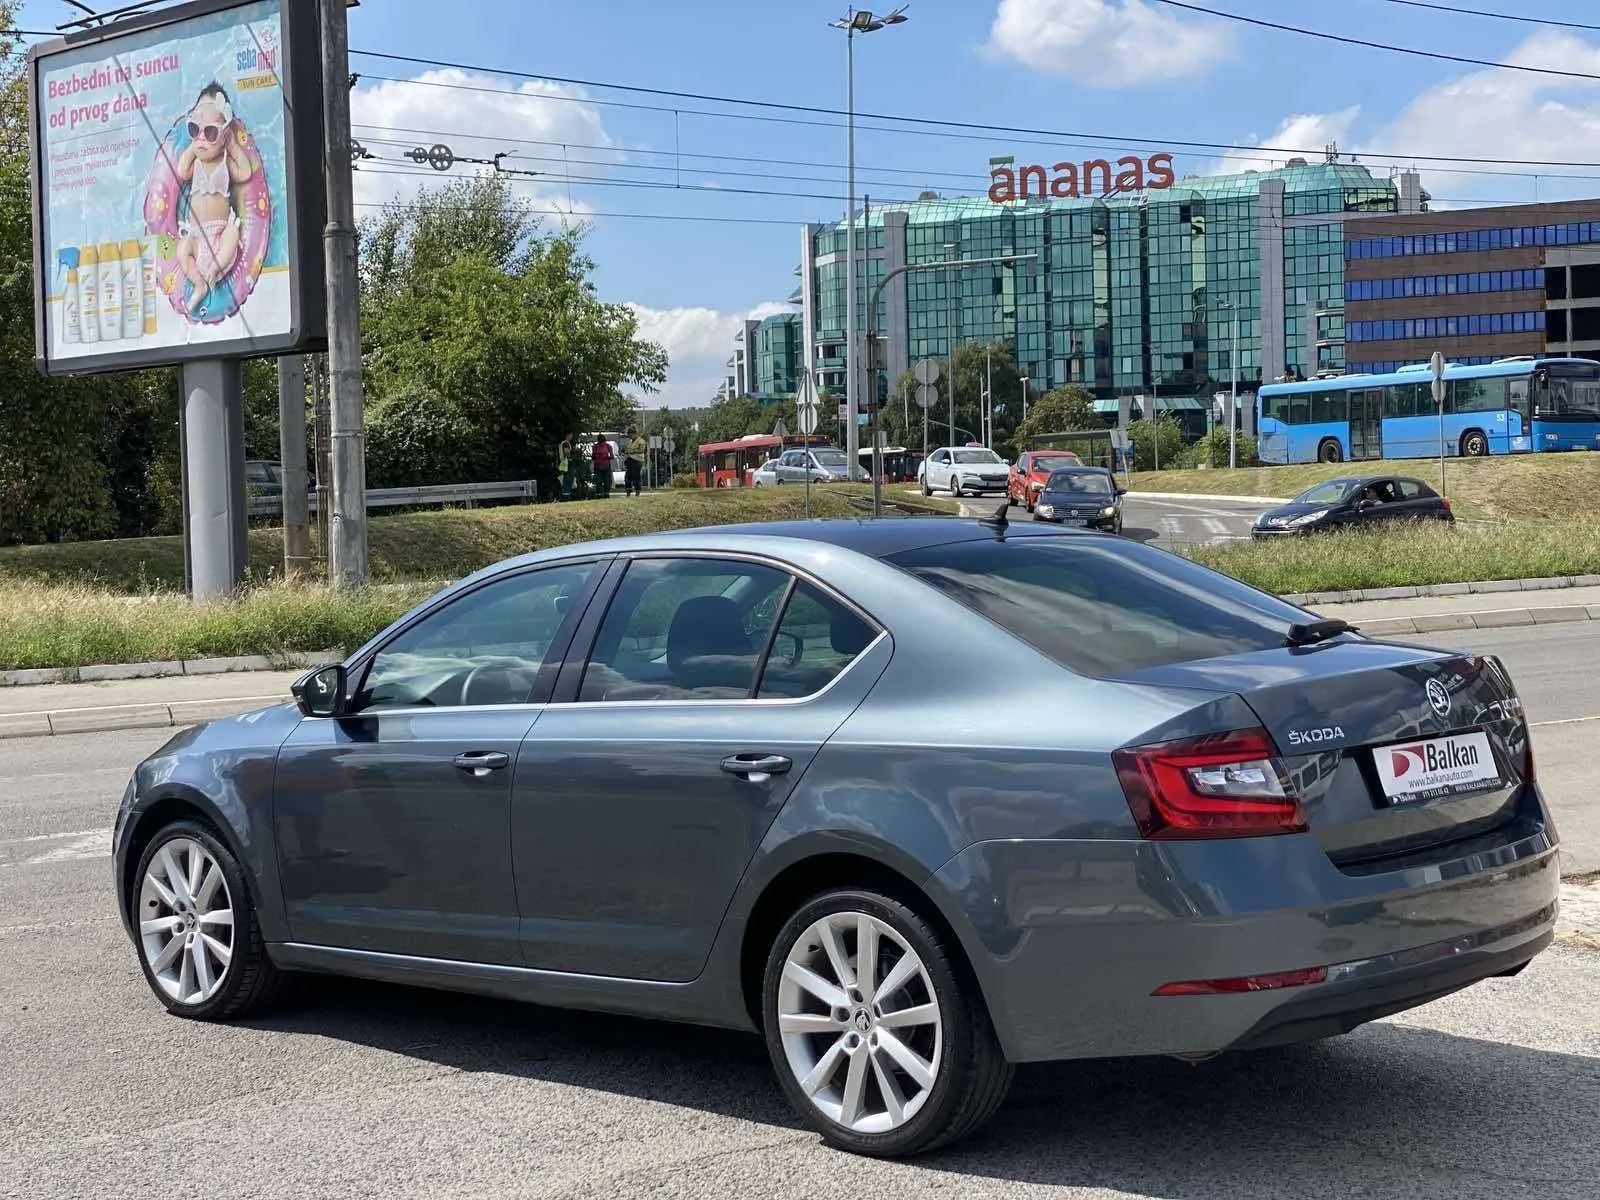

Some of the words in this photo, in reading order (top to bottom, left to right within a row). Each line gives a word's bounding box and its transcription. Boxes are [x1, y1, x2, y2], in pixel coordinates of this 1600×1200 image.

[48, 65, 111, 99] Bezbedni
[115, 66, 132, 84] na
[136, 54, 179, 78] suncu
[50, 106, 66, 128] od
[70, 102, 109, 130] prvog
[113, 92, 147, 114] dana
[1288, 726, 1345, 745] ŠKODA
[1426, 740, 1479, 772] Balkan
[1408, 769, 1473, 789] www.balkanauto.com
